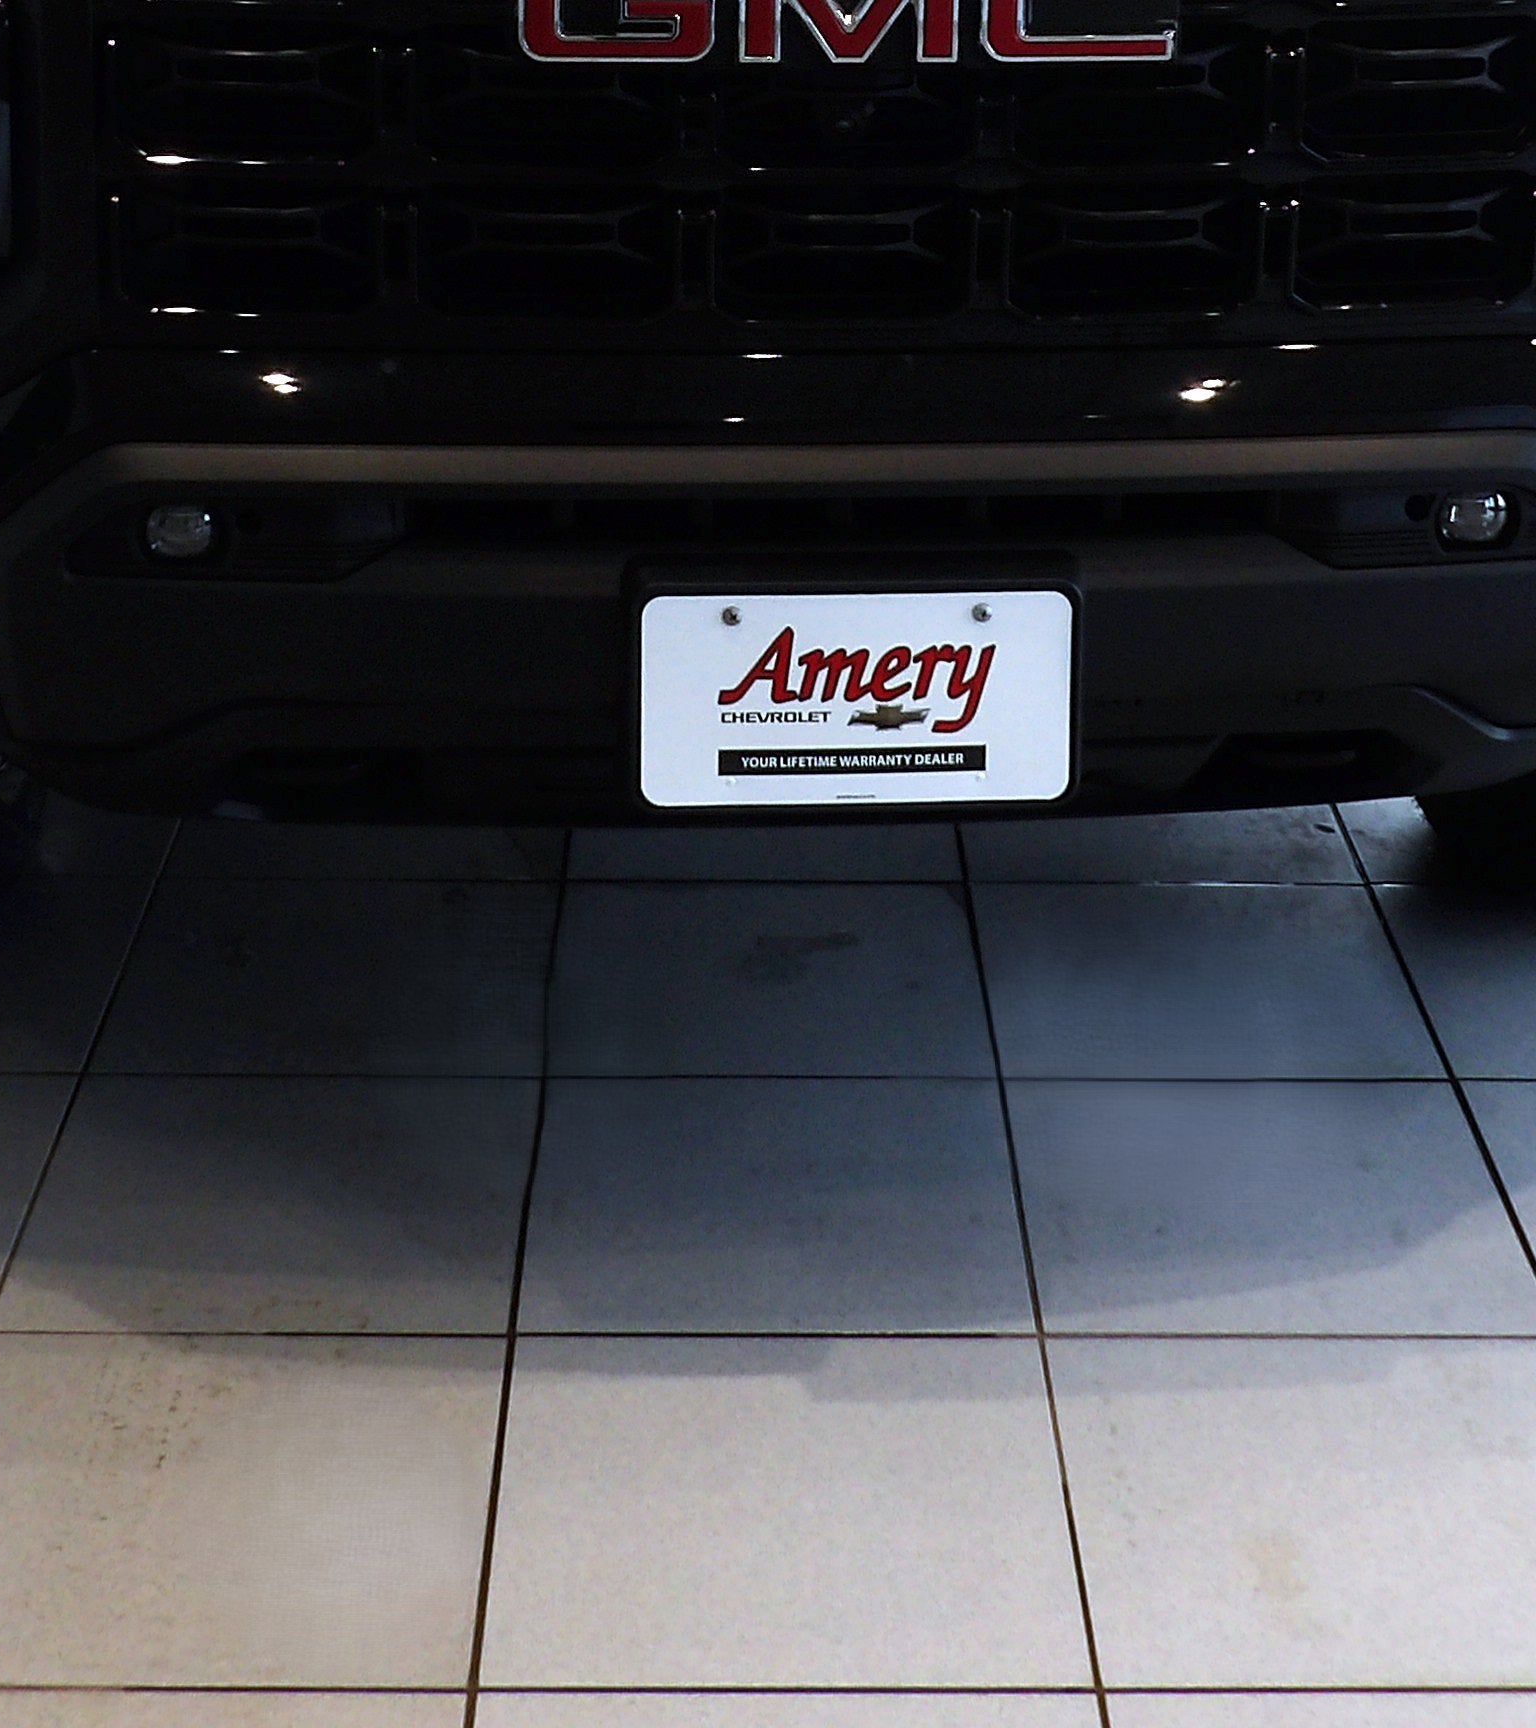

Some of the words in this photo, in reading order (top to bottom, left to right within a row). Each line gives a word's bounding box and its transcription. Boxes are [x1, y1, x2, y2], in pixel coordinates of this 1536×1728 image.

[718, 626, 996, 733] Amery
[721, 711, 831, 723] CHEVROLET
[741, 756, 777, 768] YOUR
[780, 755, 837, 768] LIFETIME
[839, 754, 913, 767] WARRANTY
[915, 752, 964, 765] DEALER
